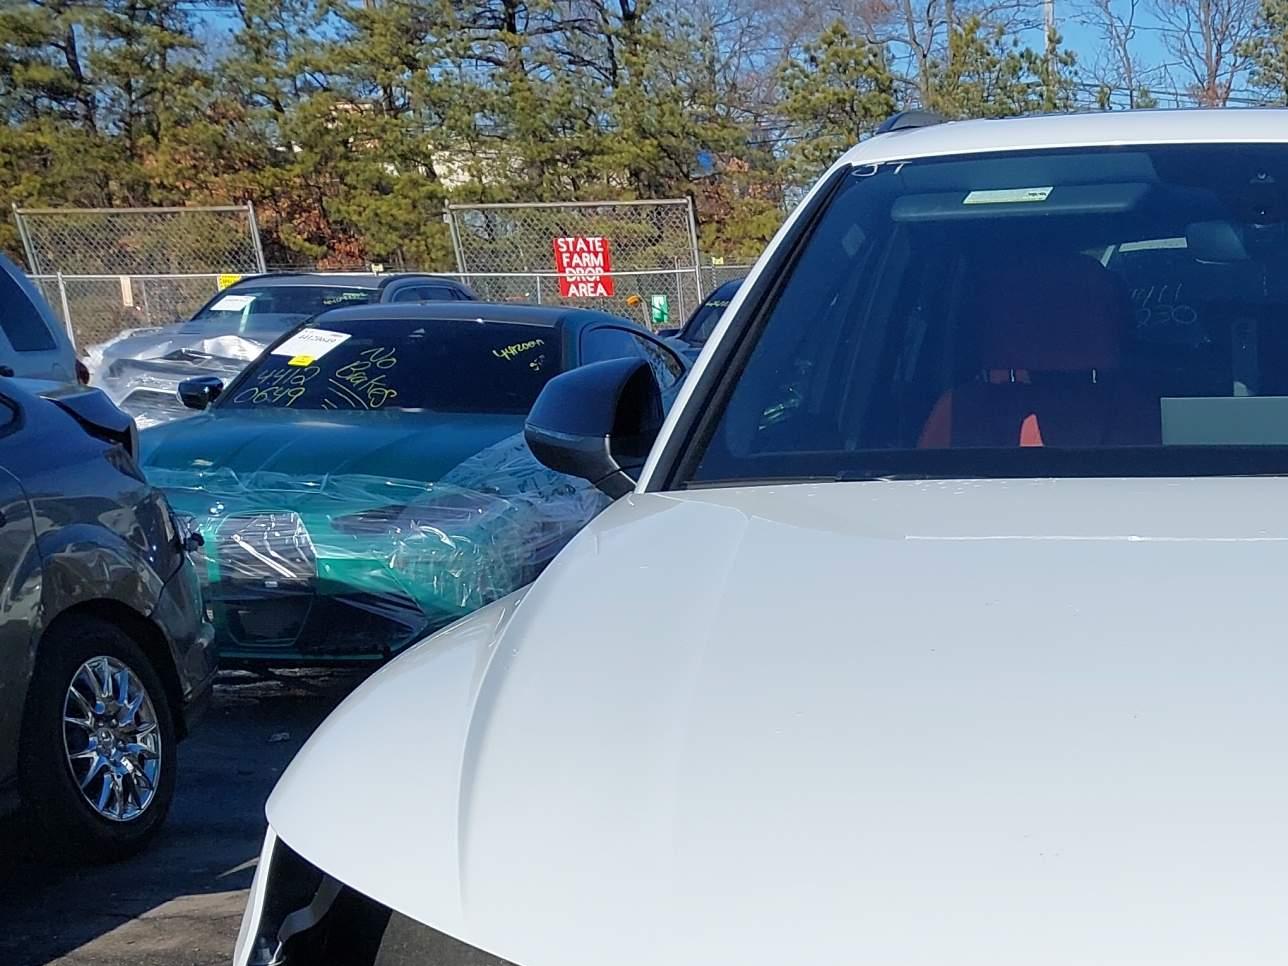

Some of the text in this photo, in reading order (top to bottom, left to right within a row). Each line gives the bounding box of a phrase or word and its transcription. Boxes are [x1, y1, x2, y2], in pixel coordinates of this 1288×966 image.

[557, 237, 604, 252] STATE
[562, 252, 604, 267] FARM
[565, 267, 605, 282] DROP
[567, 283, 608, 297] AREA
